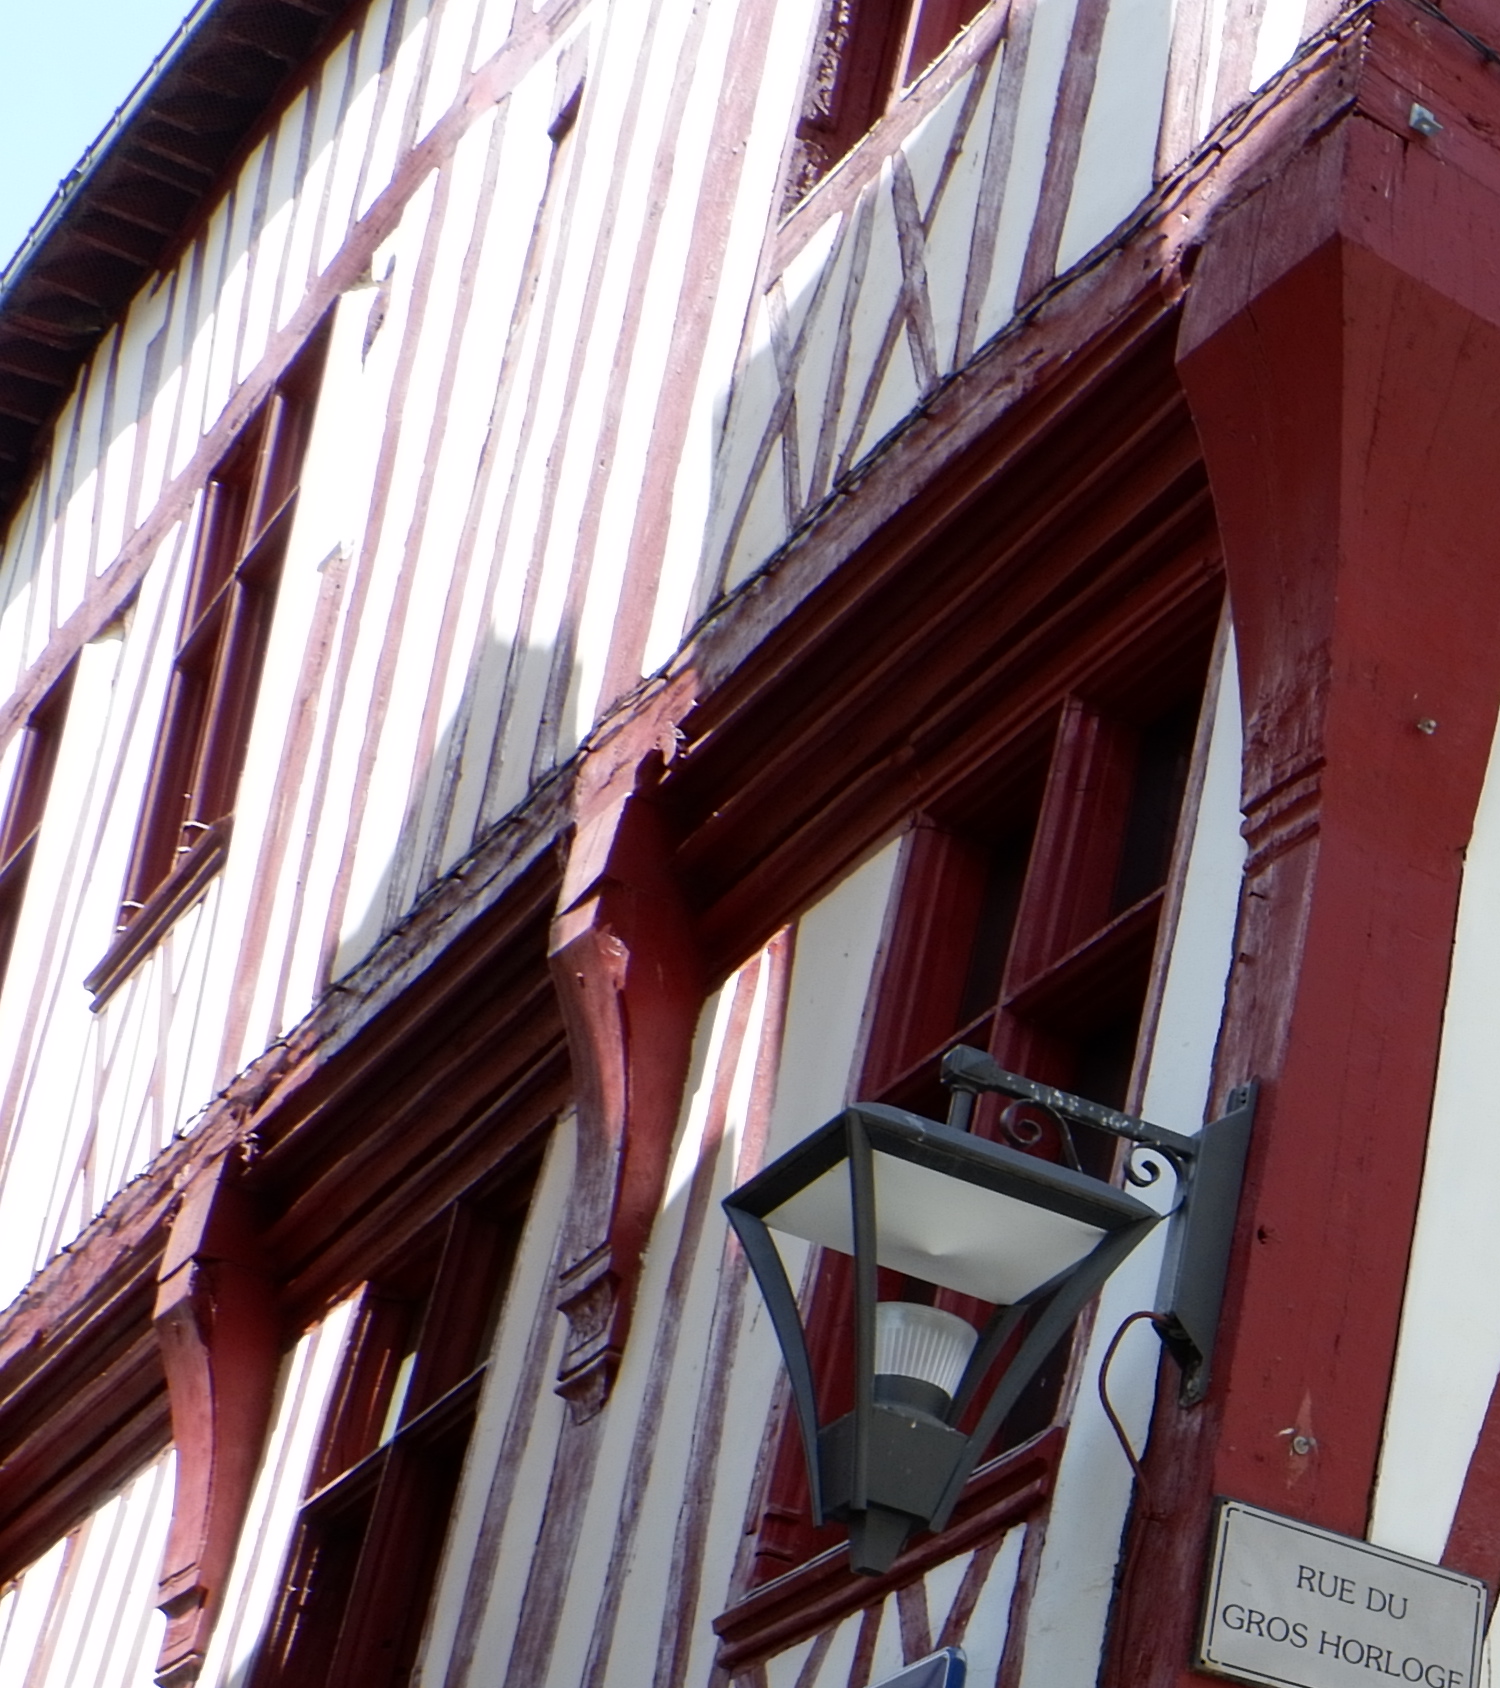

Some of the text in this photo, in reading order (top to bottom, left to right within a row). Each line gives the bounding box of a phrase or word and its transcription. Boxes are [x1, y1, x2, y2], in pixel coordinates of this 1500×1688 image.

[1296, 1563, 1408, 1620] RUE DU
[1221, 1602, 1309, 1650] GROS
